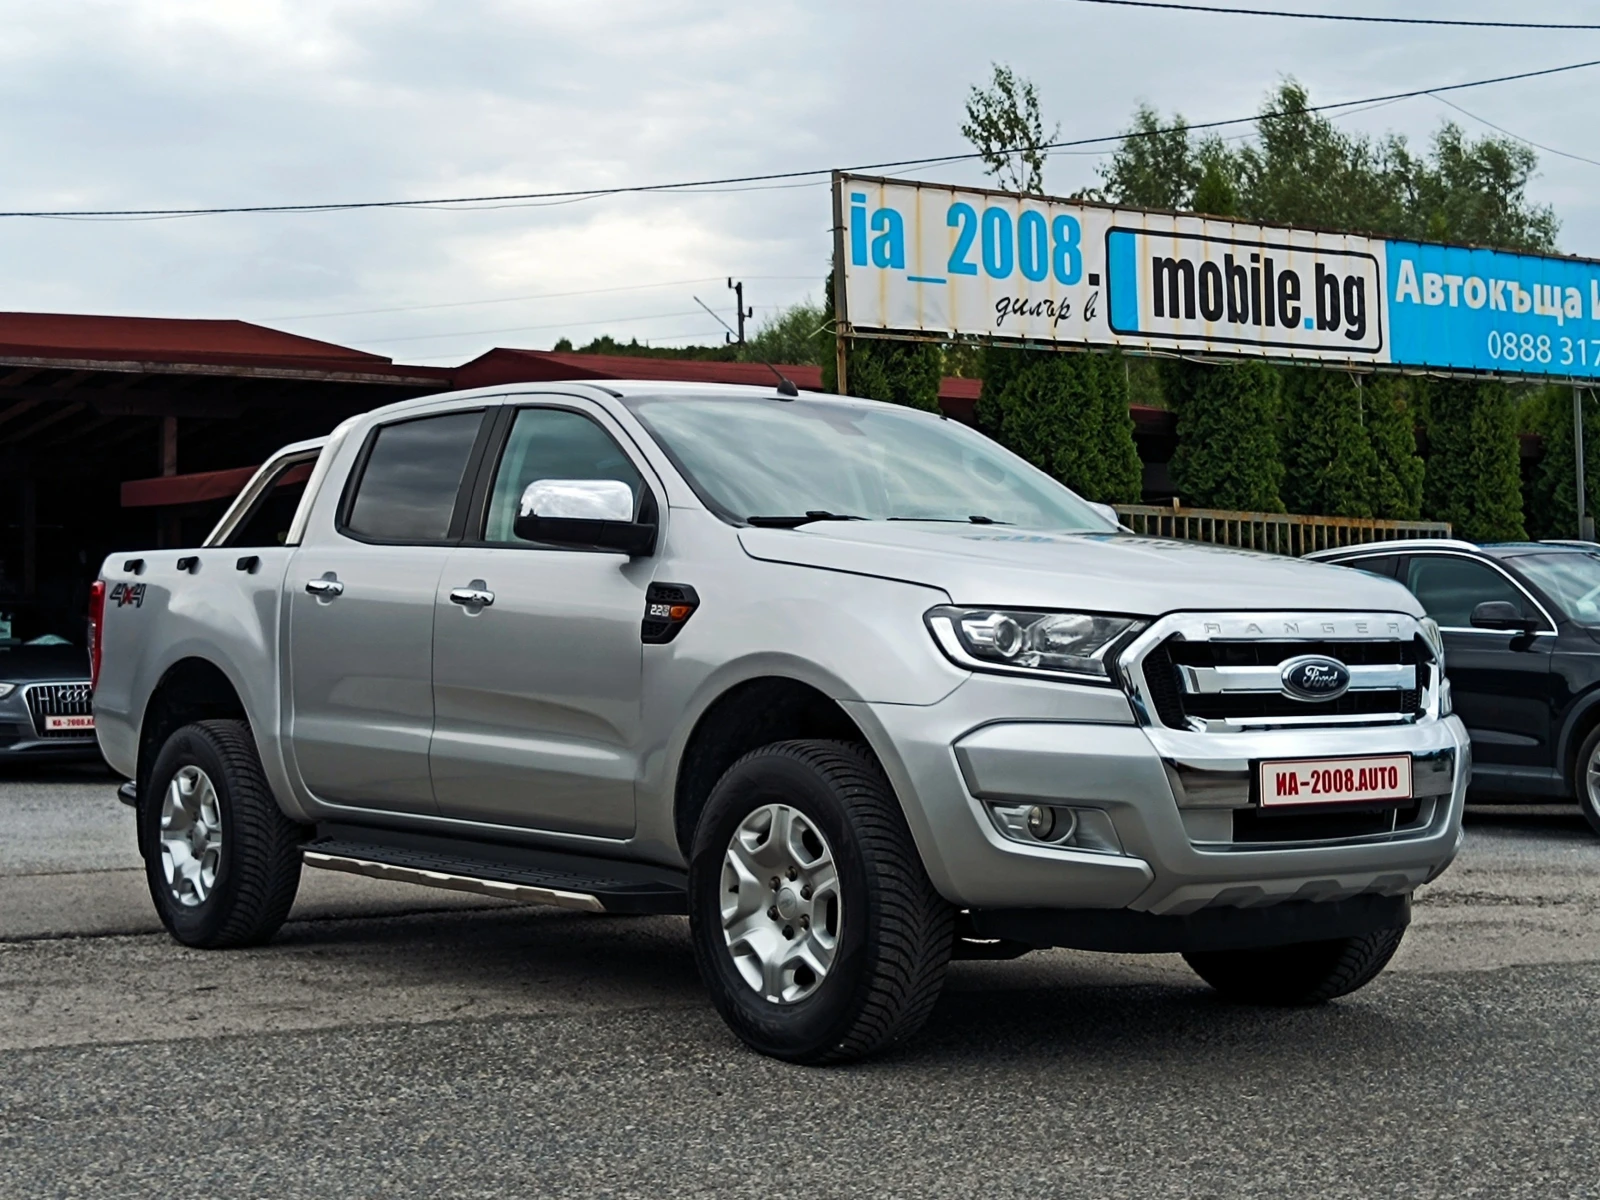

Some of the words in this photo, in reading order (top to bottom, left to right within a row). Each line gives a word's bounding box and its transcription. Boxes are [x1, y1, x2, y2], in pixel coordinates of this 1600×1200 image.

[995, 296, 1071, 328] дилър
[1084, 291, 1098, 322] в
[1152, 252, 1366, 341] mobile.bg
[1395, 259, 1582, 327] Автокъща
[1487, 330, 1552, 363] 0888
[1560, 336, 1600, 367] 317
[1203, 622, 1400, 634] RANGER
[1302, 665, 1338, 688] Ford
